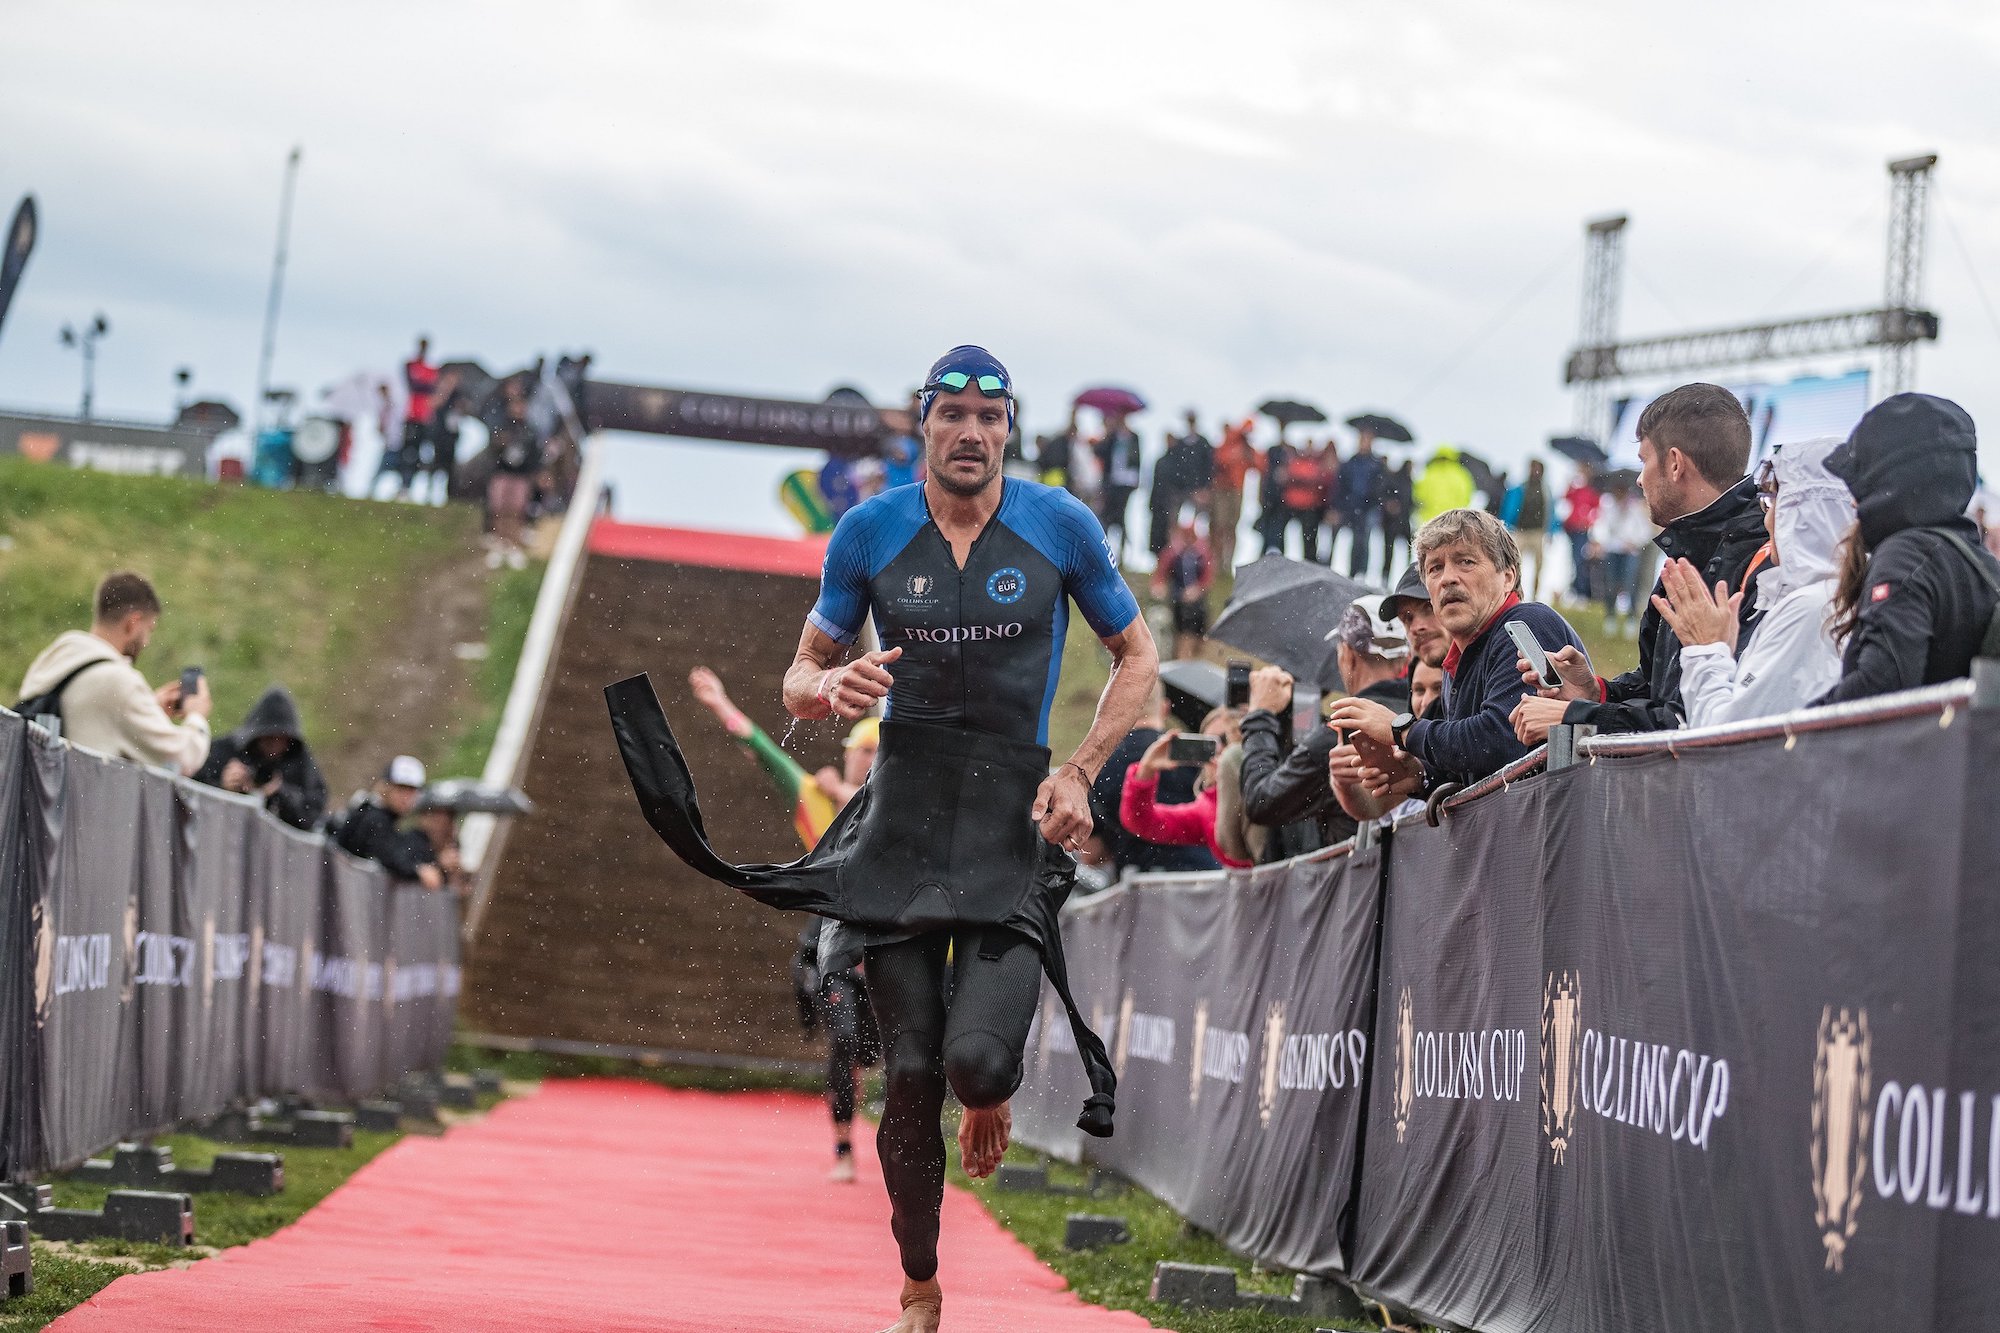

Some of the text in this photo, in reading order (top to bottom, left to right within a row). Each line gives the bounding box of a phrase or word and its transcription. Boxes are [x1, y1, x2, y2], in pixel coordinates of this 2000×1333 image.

[998, 583, 1016, 592] EUR
[904, 622, 1023, 643] FRODENO
[1414, 1029, 1525, 1101] COLLINS CUP
[1581, 1028, 1730, 1151] COLLINS CUP
